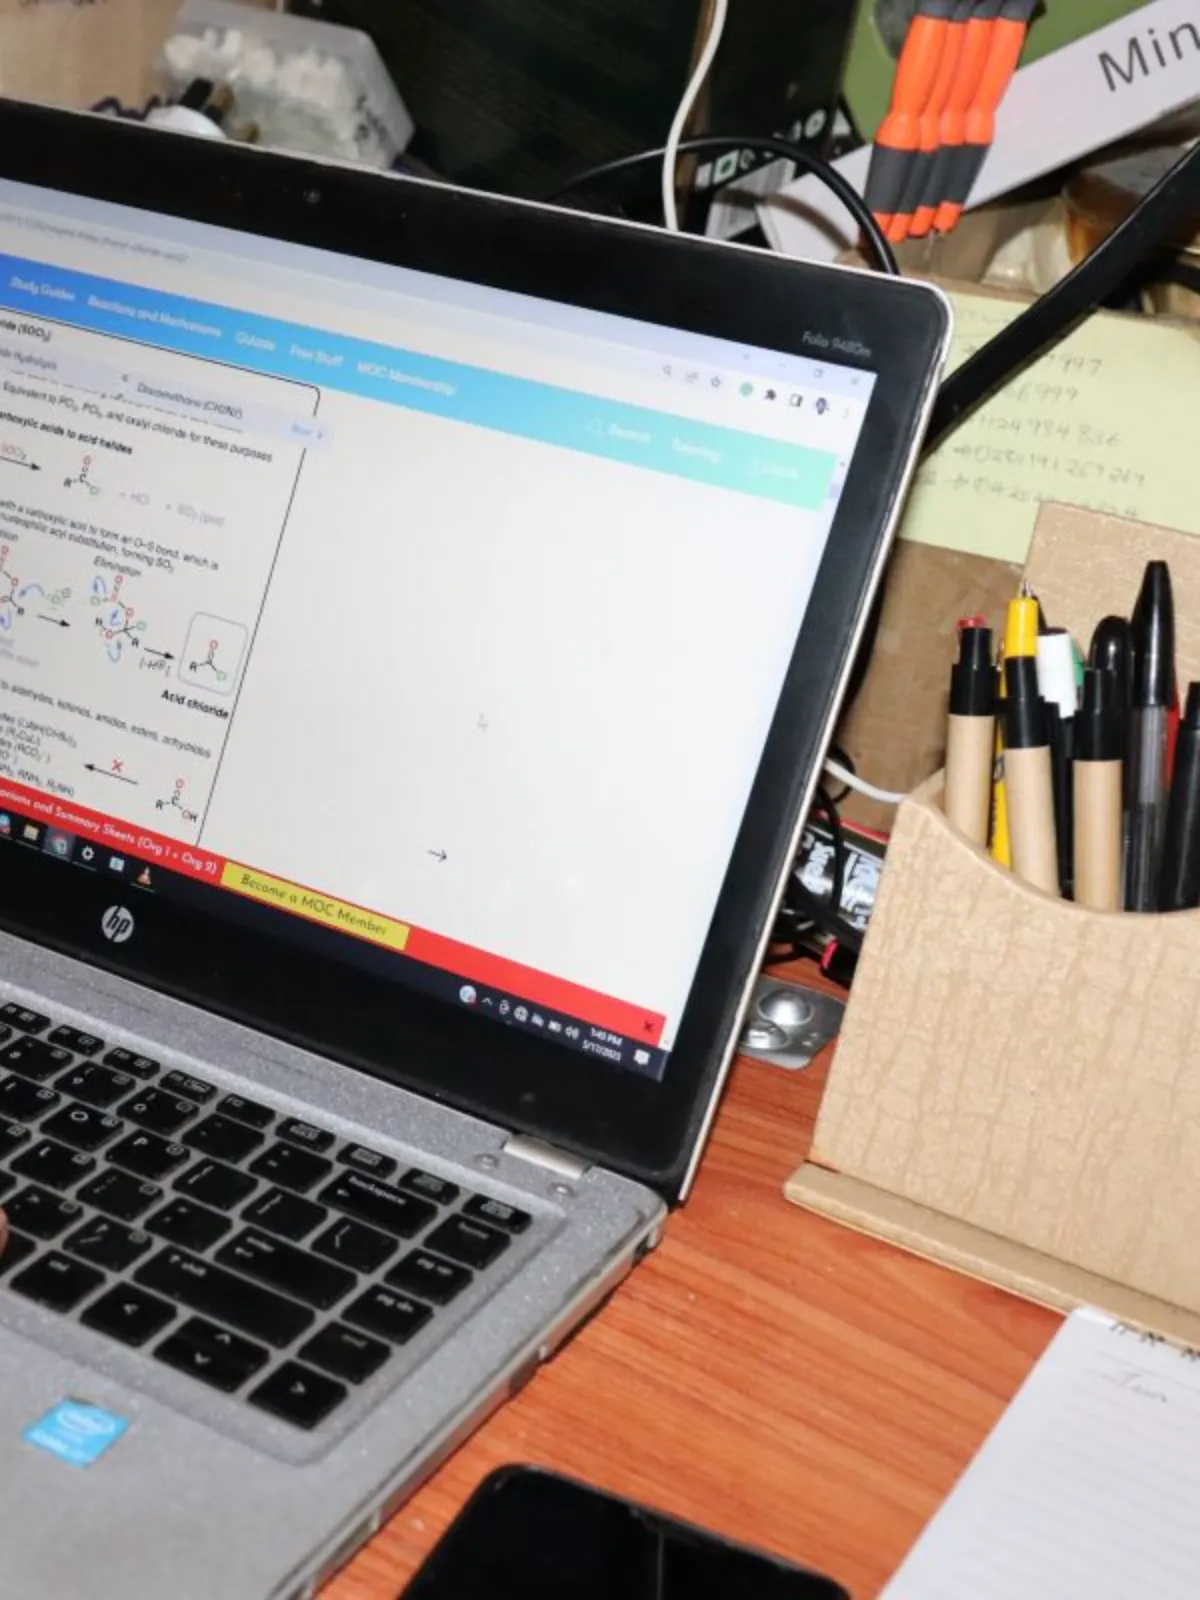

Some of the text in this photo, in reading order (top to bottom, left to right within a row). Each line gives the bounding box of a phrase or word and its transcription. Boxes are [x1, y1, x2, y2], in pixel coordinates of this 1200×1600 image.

[1097, 21, 1200, 93] Min
[801, 330, 830, 348] Folio
[160, 687, 185, 706] Acid
[239, 871, 288, 901] Become
[300, 893, 334, 918] MOC
[335, 906, 389, 938] Member
[103, 905, 134, 942] hp
